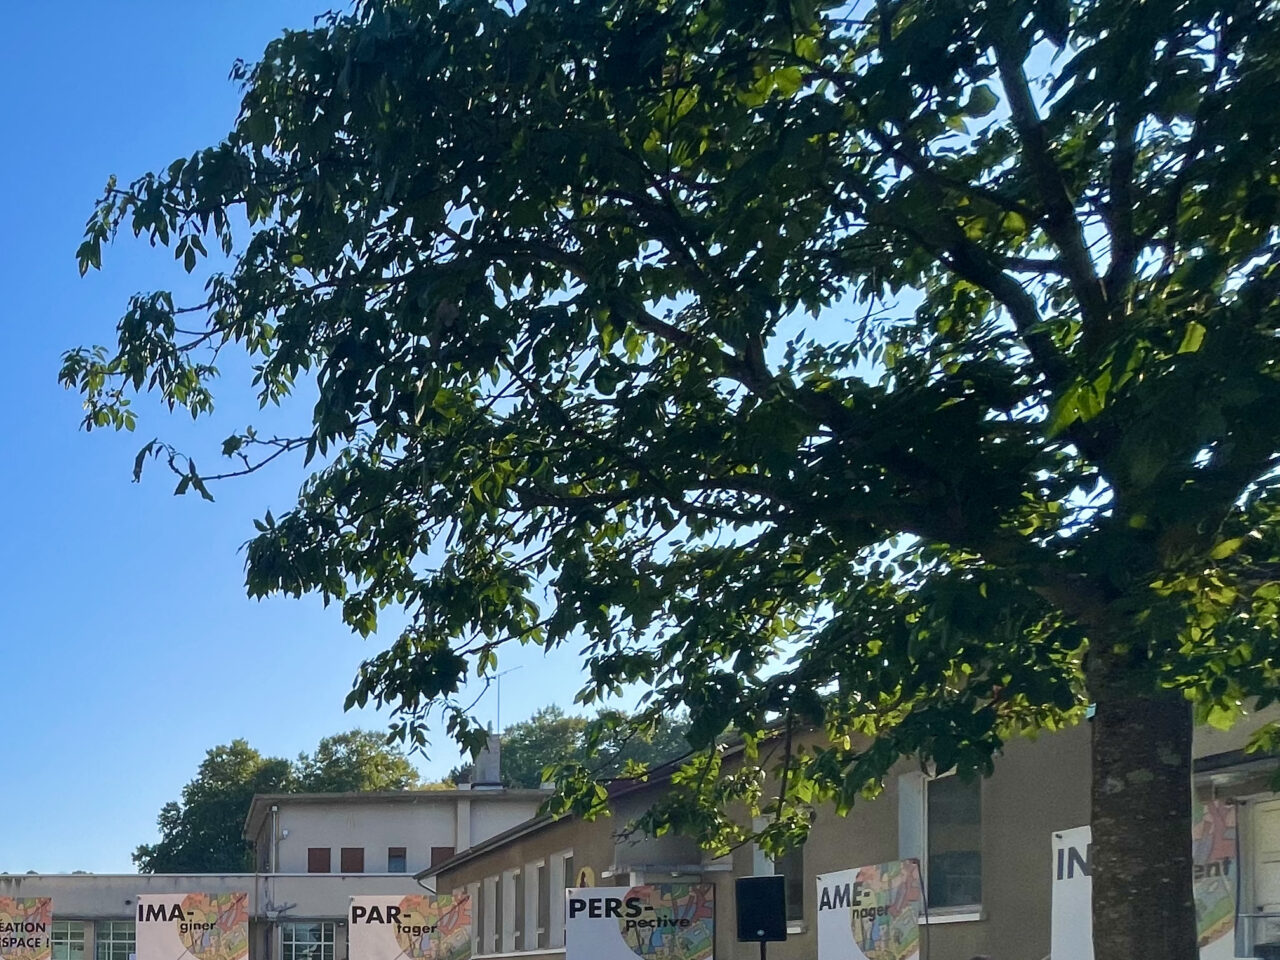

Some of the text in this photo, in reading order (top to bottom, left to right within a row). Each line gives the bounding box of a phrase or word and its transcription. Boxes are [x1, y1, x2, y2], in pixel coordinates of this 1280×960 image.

[138, 904, 194, 922] IMA-
[352, 906, 411, 924] PAR-
[569, 897, 654, 918] PERS-
[852, 904, 890, 922] nager
[179, 920, 216, 934] giner
[397, 924, 438, 936] tager
[626, 915, 690, 931] pective
